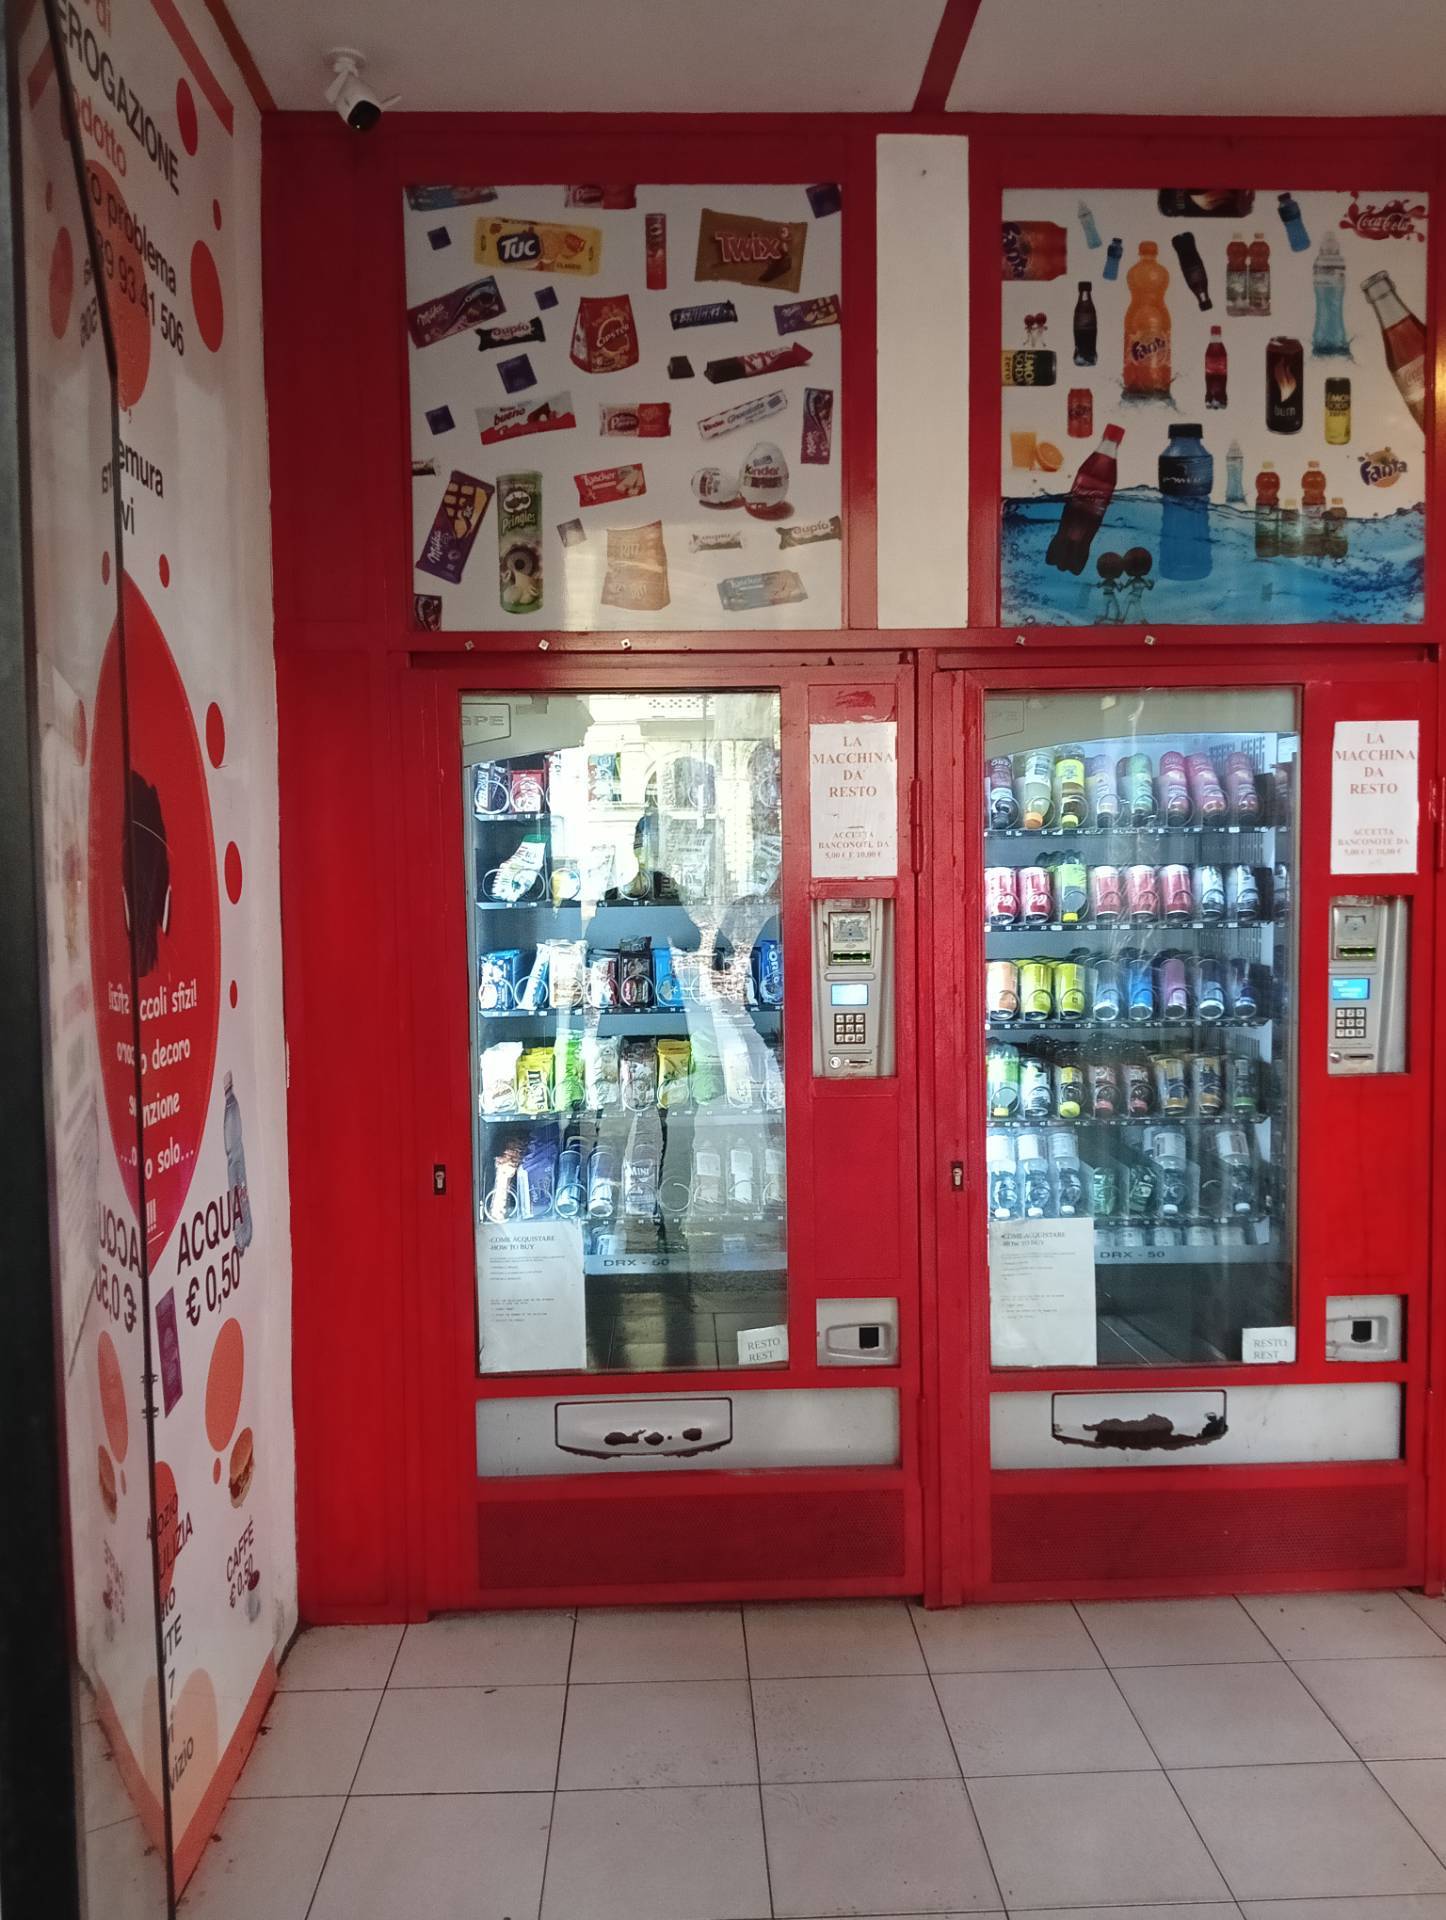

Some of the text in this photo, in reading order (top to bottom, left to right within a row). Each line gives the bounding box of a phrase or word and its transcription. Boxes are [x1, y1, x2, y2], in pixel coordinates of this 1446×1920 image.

[107, 193, 176, 296] problema
[500, 236, 537, 261] TUC
[160, 301, 185, 357] 506
[494, 406, 526, 426] bueno
[1359, 458, 1408, 486] Fanta
[501, 511, 537, 538] Pringles
[843, 736, 862, 747] LA
[1366, 733, 1385, 744] LA
[812, 752, 894, 764] MACCHINA
[1335, 749, 1416, 761] MACCHINA
[843, 770, 863, 781] DA
[1364, 766, 1385, 778] DA
[829, 786, 878, 798] RESTO
[1350, 783, 1398, 795] RESTO
[171, 978, 197, 1013] sfizi!
[152, 1038, 191, 1071] decoro
[177, 1184, 243, 1276] ACQUA
[603, 1259, 635, 1267] DRX
[186, 1244, 241, 1327] € 0,50
[747, 1337, 781, 1350] RESTO
[1253, 1338, 1288, 1348] RESTO
[748, 1350, 775, 1361] REST
[1253, 1350, 1280, 1359] REST
